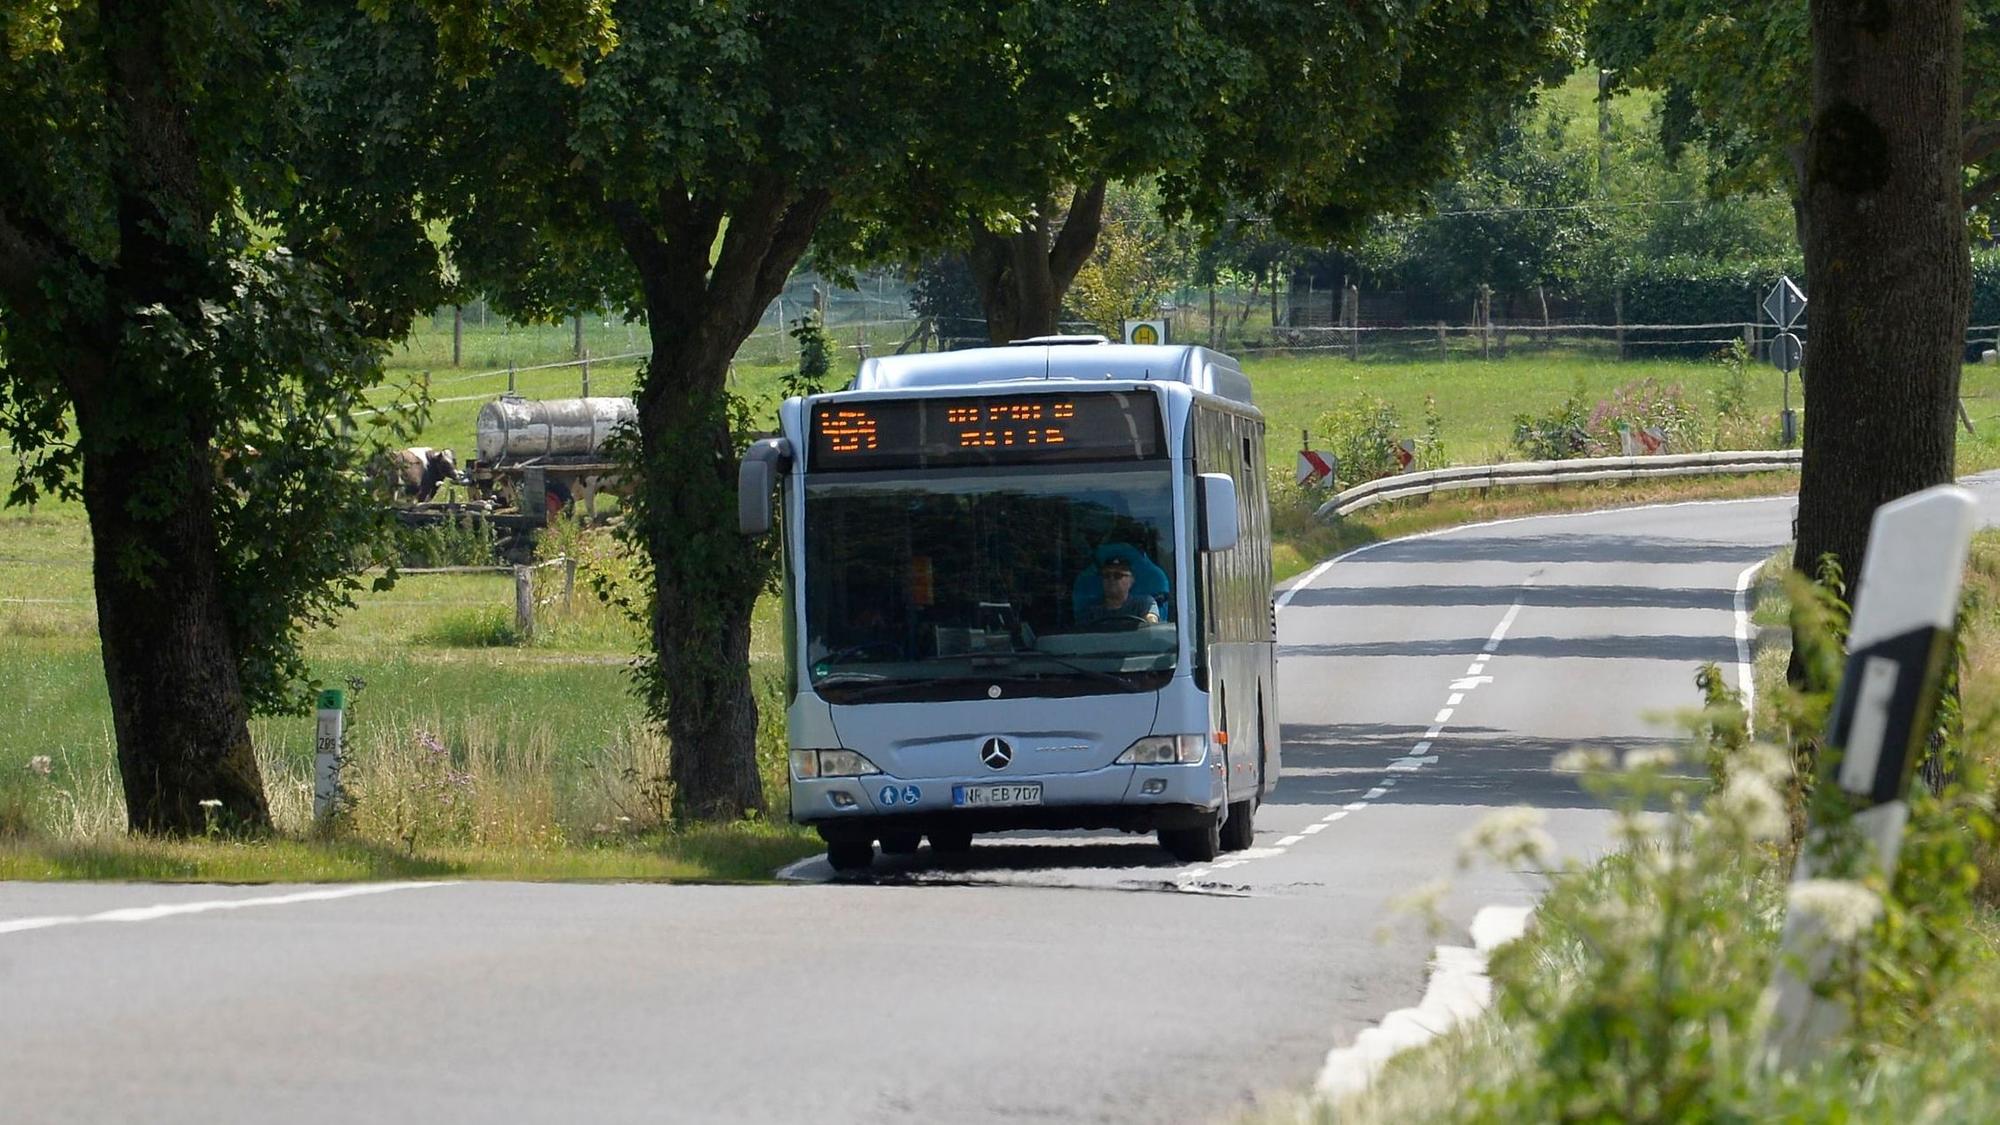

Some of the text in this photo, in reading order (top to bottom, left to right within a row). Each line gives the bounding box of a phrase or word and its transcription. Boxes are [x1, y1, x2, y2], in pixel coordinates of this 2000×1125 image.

[1139, 329, 1150, 345] H
[991, 787, 1010, 802] EB
[1013, 786, 1040, 801] 707
